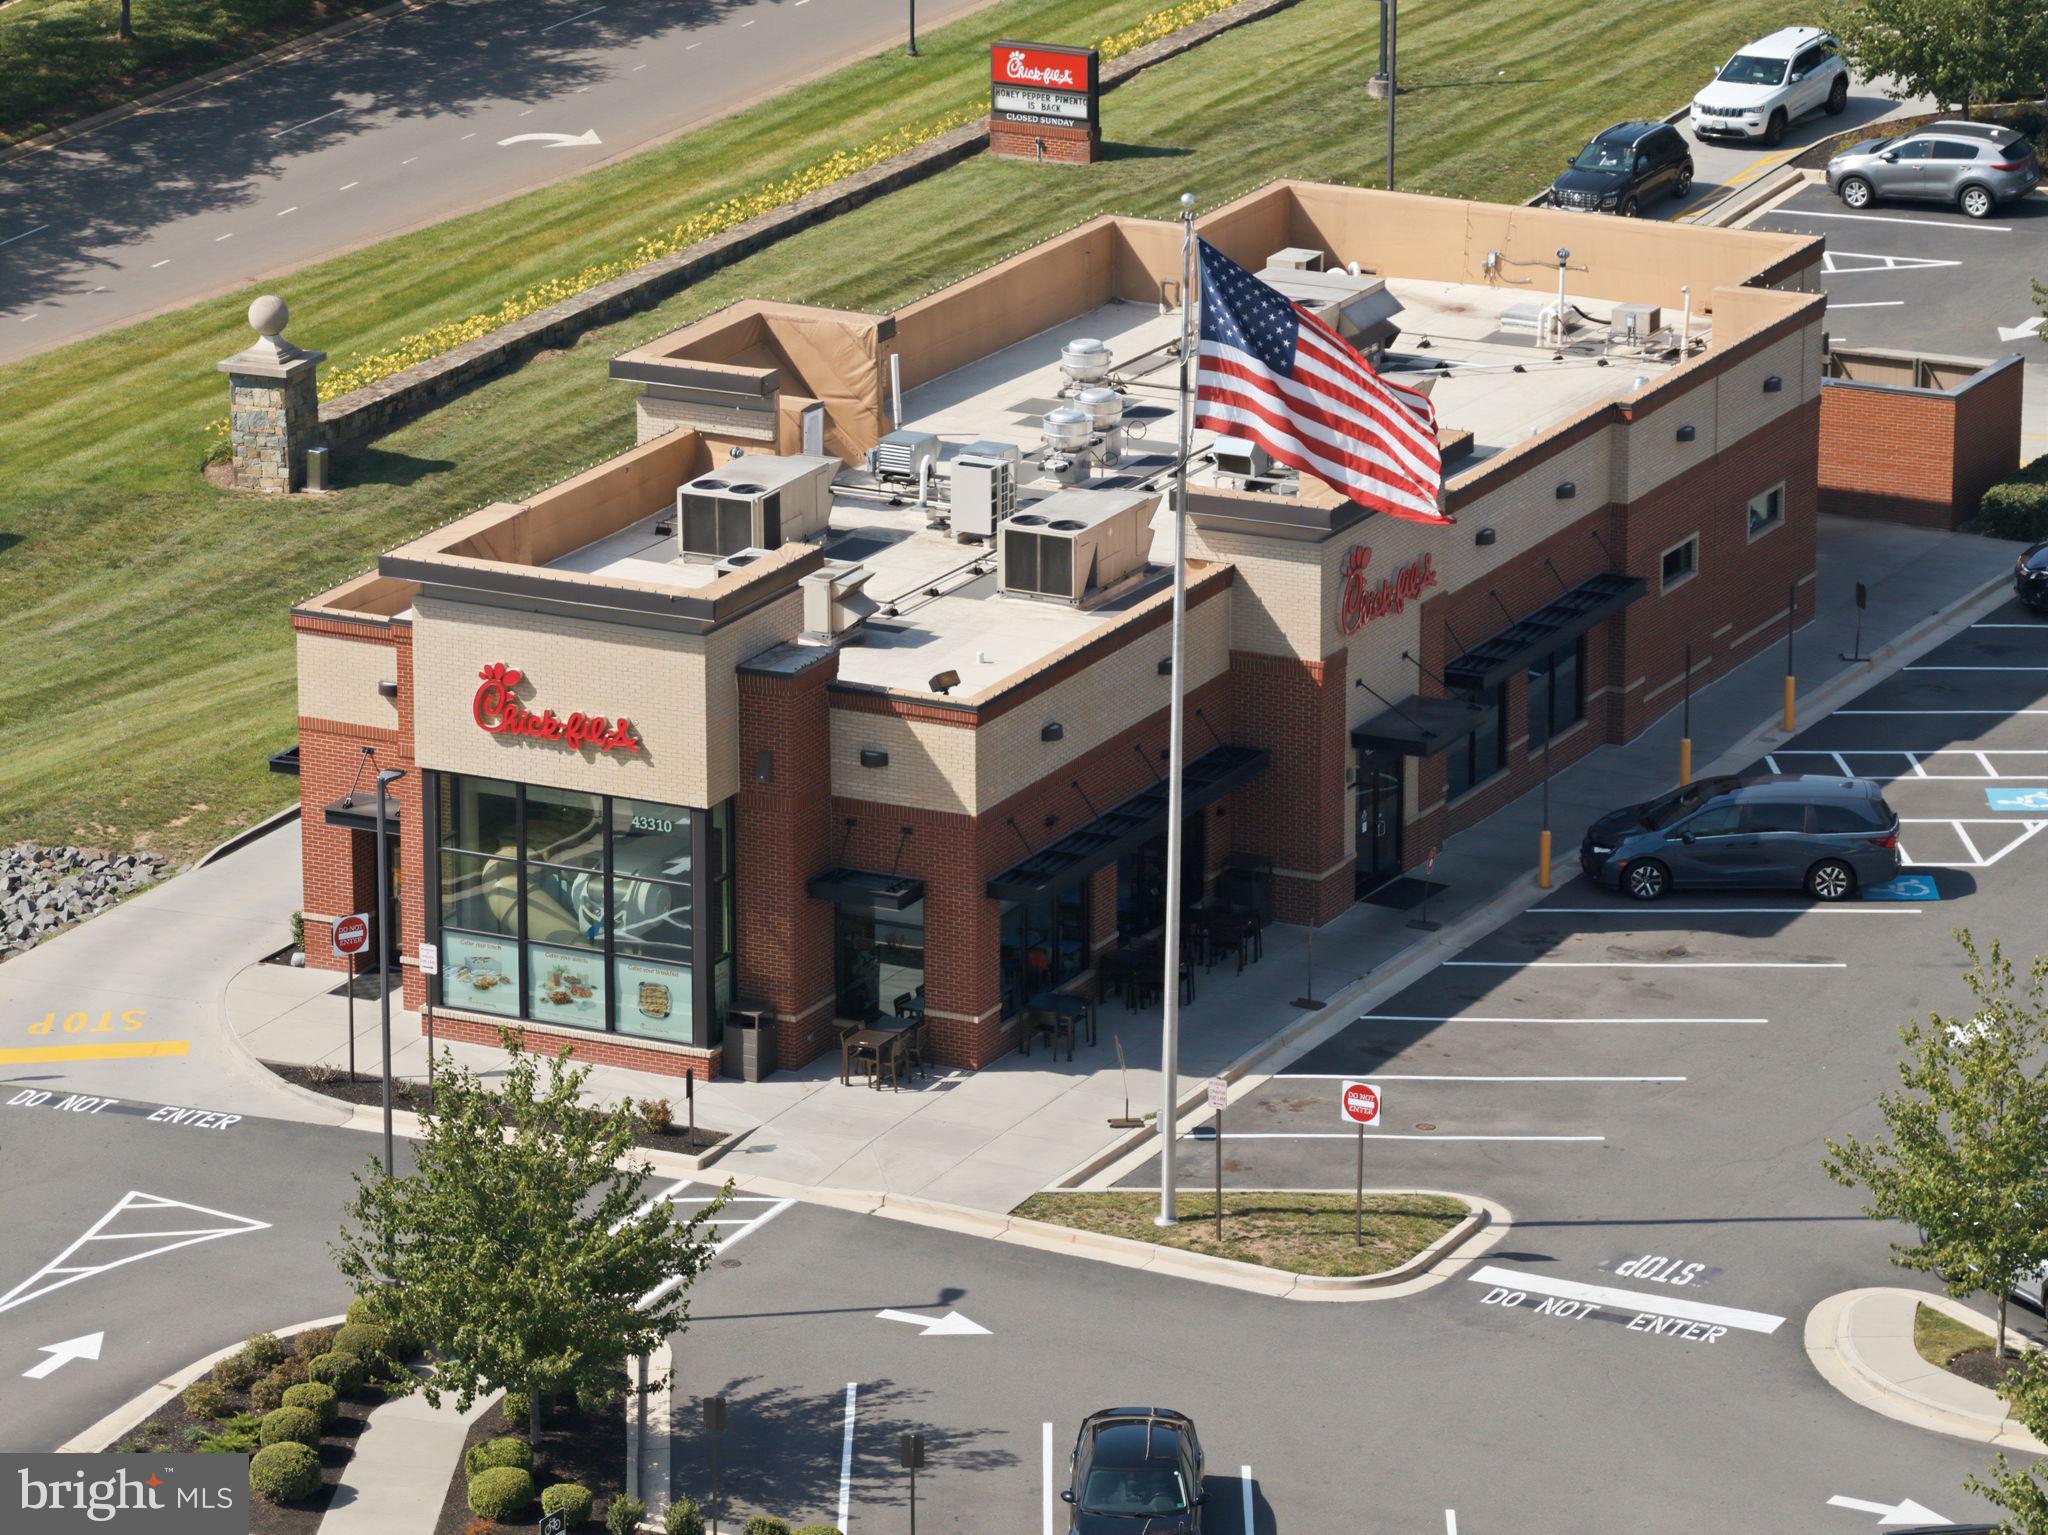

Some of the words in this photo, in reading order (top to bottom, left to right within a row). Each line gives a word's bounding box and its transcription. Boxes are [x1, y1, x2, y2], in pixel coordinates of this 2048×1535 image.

[1007, 50, 1073, 84] Chick-fil-A
[995, 88, 1019, 98] HONEY
[1022, 91, 1051, 102] PEPPER
[1055, 95, 1087, 106] PIMENTO
[1028, 101, 1035, 109] IS
[1041, 103, 1061, 112] BACK
[1006, 112, 1039, 123] CLOSED
[1040, 116, 1074, 127] SUNDAY
[1341, 545, 1437, 635] Chick-fil-A
[472, 662, 639, 753] Chick-fil-A
[632, 816, 672, 833] 43310
[350, 923, 363, 931] NOT
[340, 938, 362, 946] ENTER
[27, 1009, 146, 1035] STOP
[1360, 1093, 1375, 1102] NOT
[6, 1089, 53, 1107] DO
[54, 1094, 119, 1114] NOT
[146, 1106, 242, 1130] ENTER
[1349, 1105, 1373, 1116] ENTER
[1614, 1254, 1705, 1286] STOP
[1480, 1287, 1527, 1308] DO
[1534, 1297, 1602, 1321] NOT
[1625, 1313, 1728, 1344] ENTER
